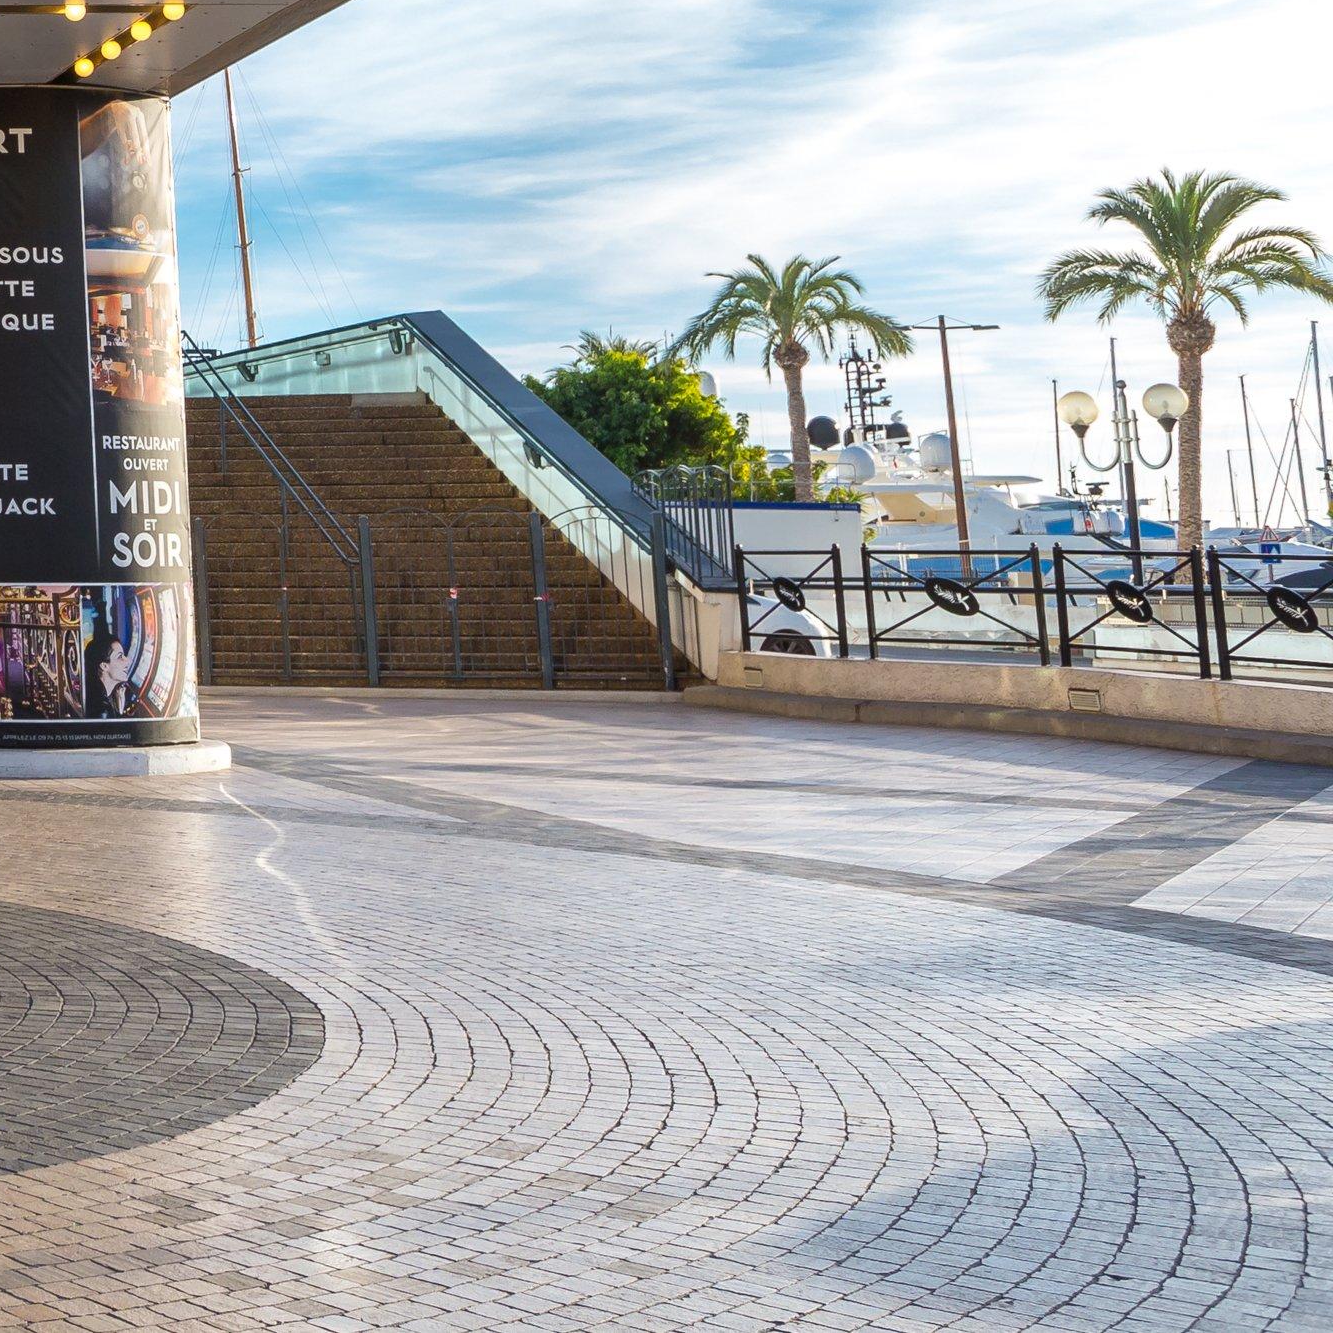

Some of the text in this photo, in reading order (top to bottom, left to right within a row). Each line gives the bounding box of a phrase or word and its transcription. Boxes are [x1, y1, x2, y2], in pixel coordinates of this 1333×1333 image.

[102, 435, 181, 452] RESTAURANT
[123, 457, 169, 471] OUVERT
[109, 479, 181, 514] MIDI
[144, 518, 158, 531] ET
[112, 532, 183, 567] SOIR
